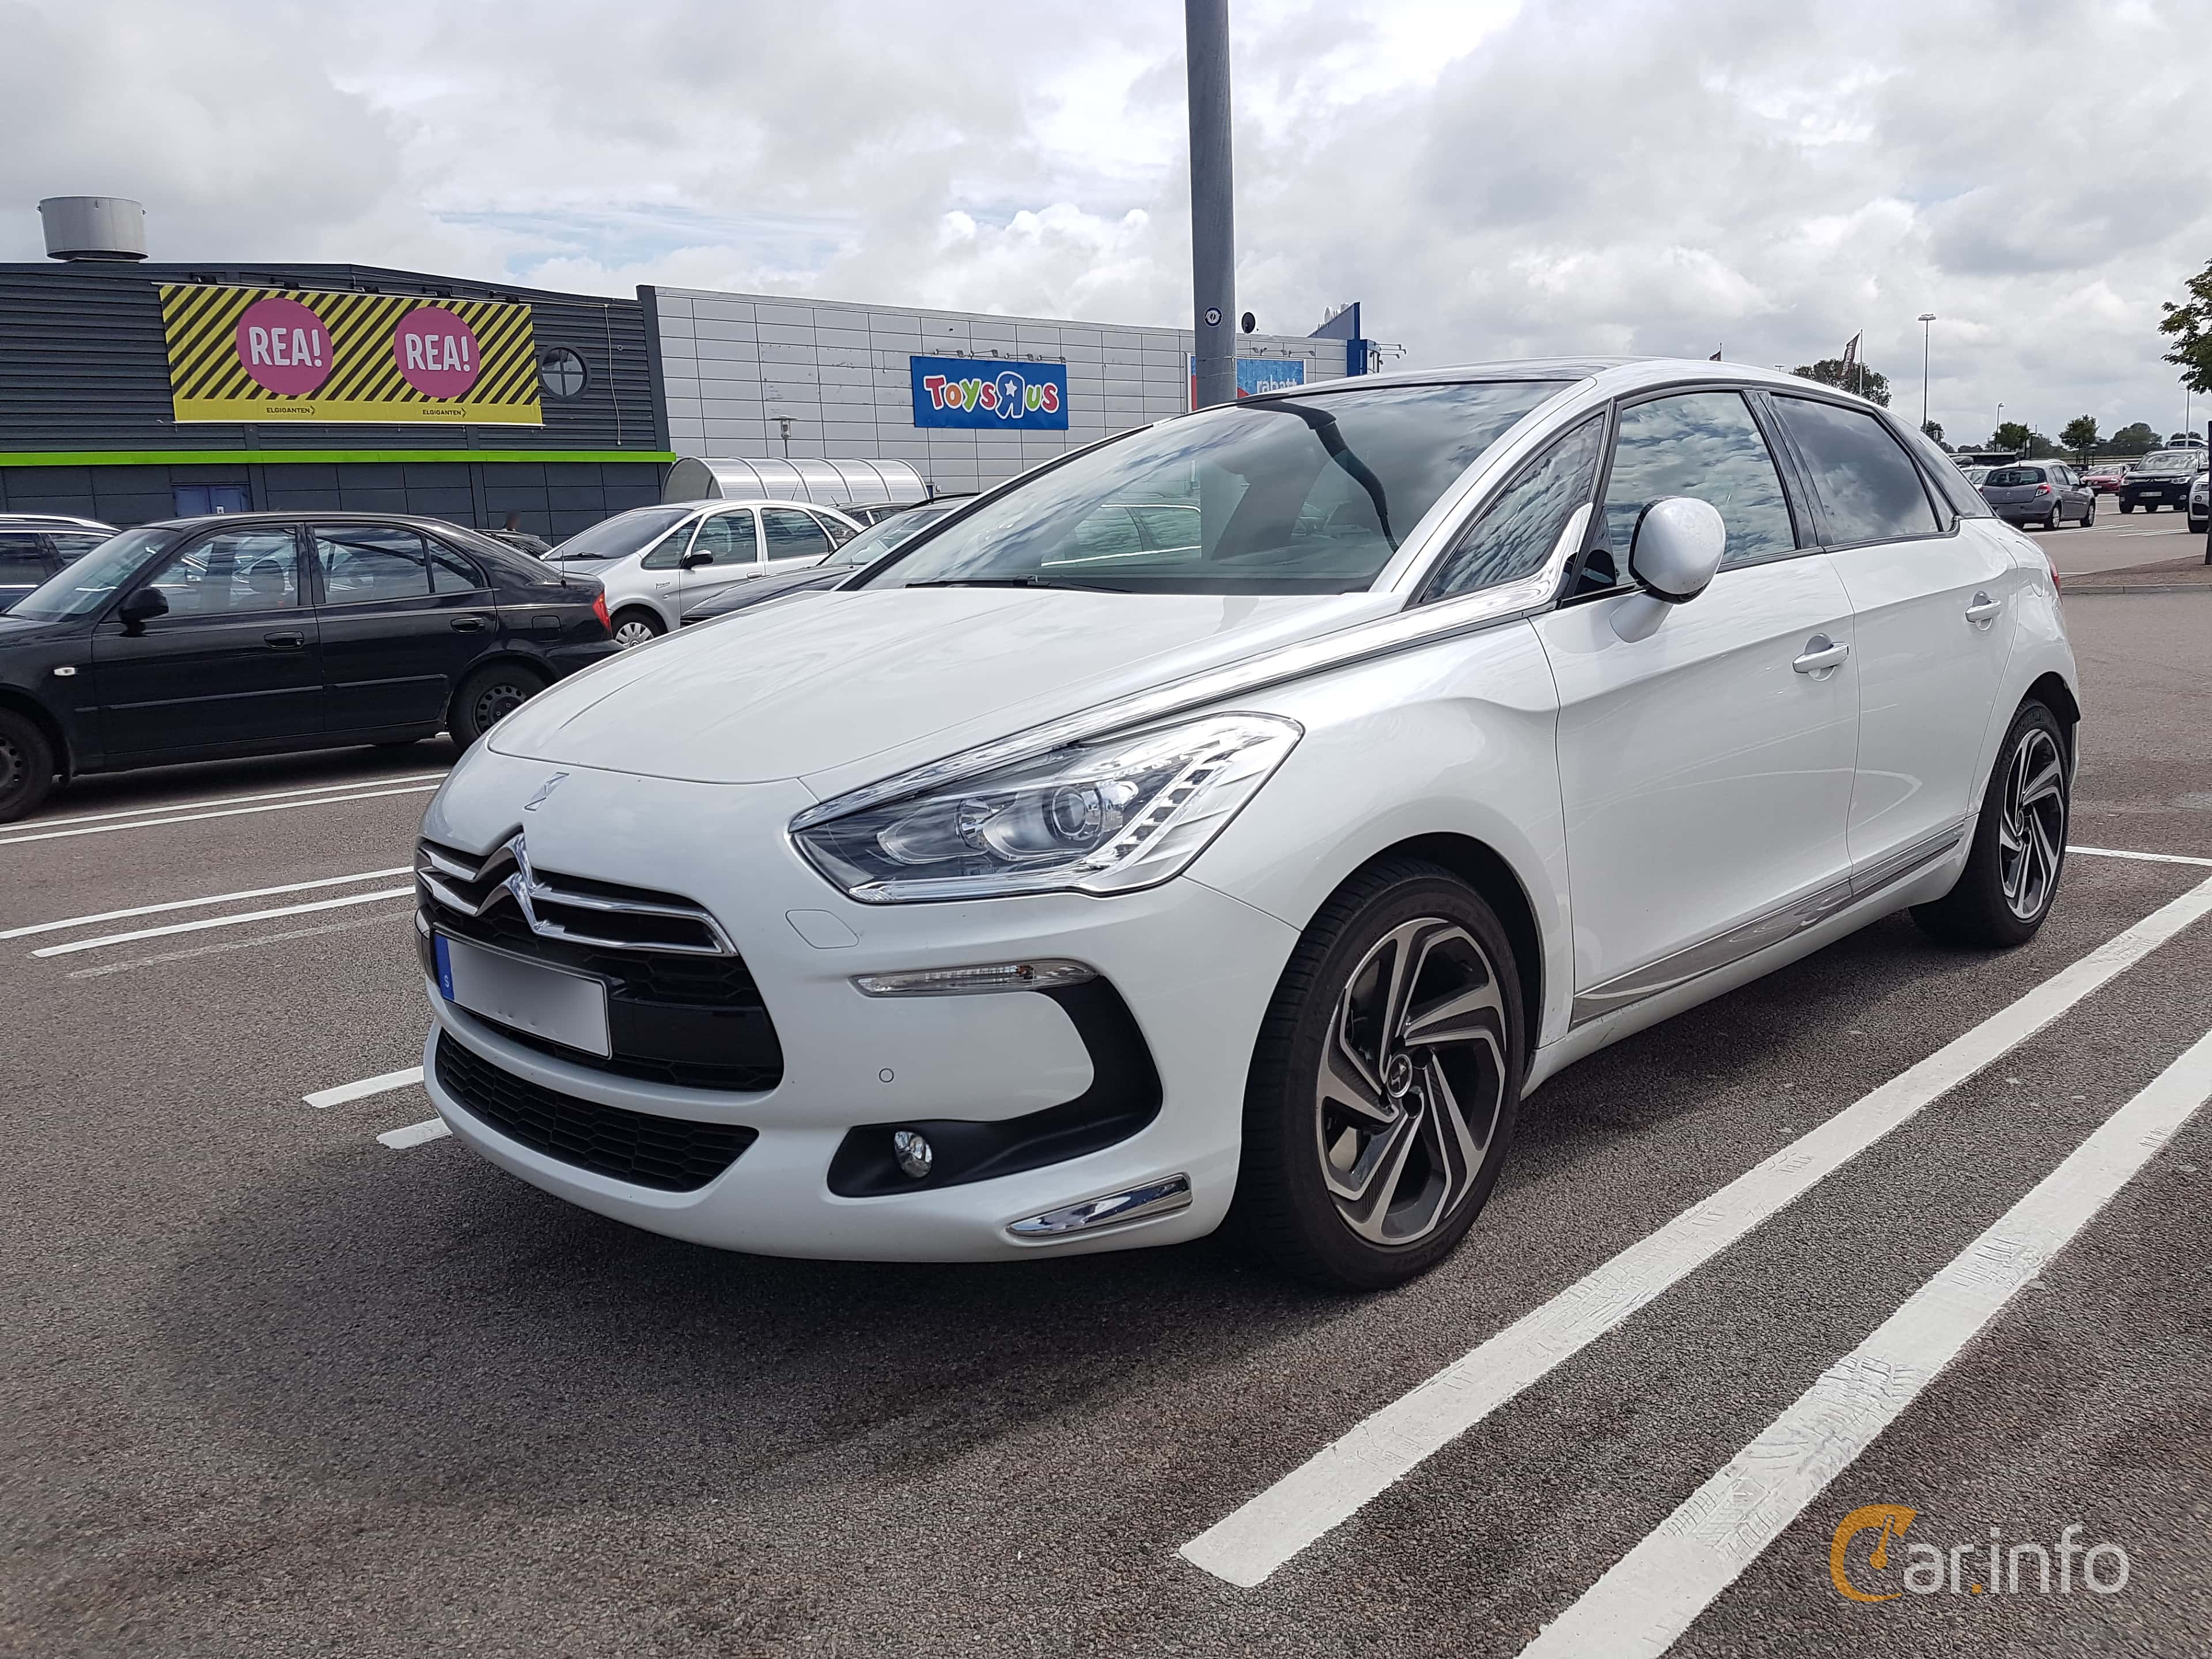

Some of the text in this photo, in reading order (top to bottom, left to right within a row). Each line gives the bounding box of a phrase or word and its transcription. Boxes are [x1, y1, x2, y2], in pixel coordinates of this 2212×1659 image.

[248, 326, 322, 368] REA!
[405, 333, 471, 372] REA!
[444, 974, 449, 988] S
